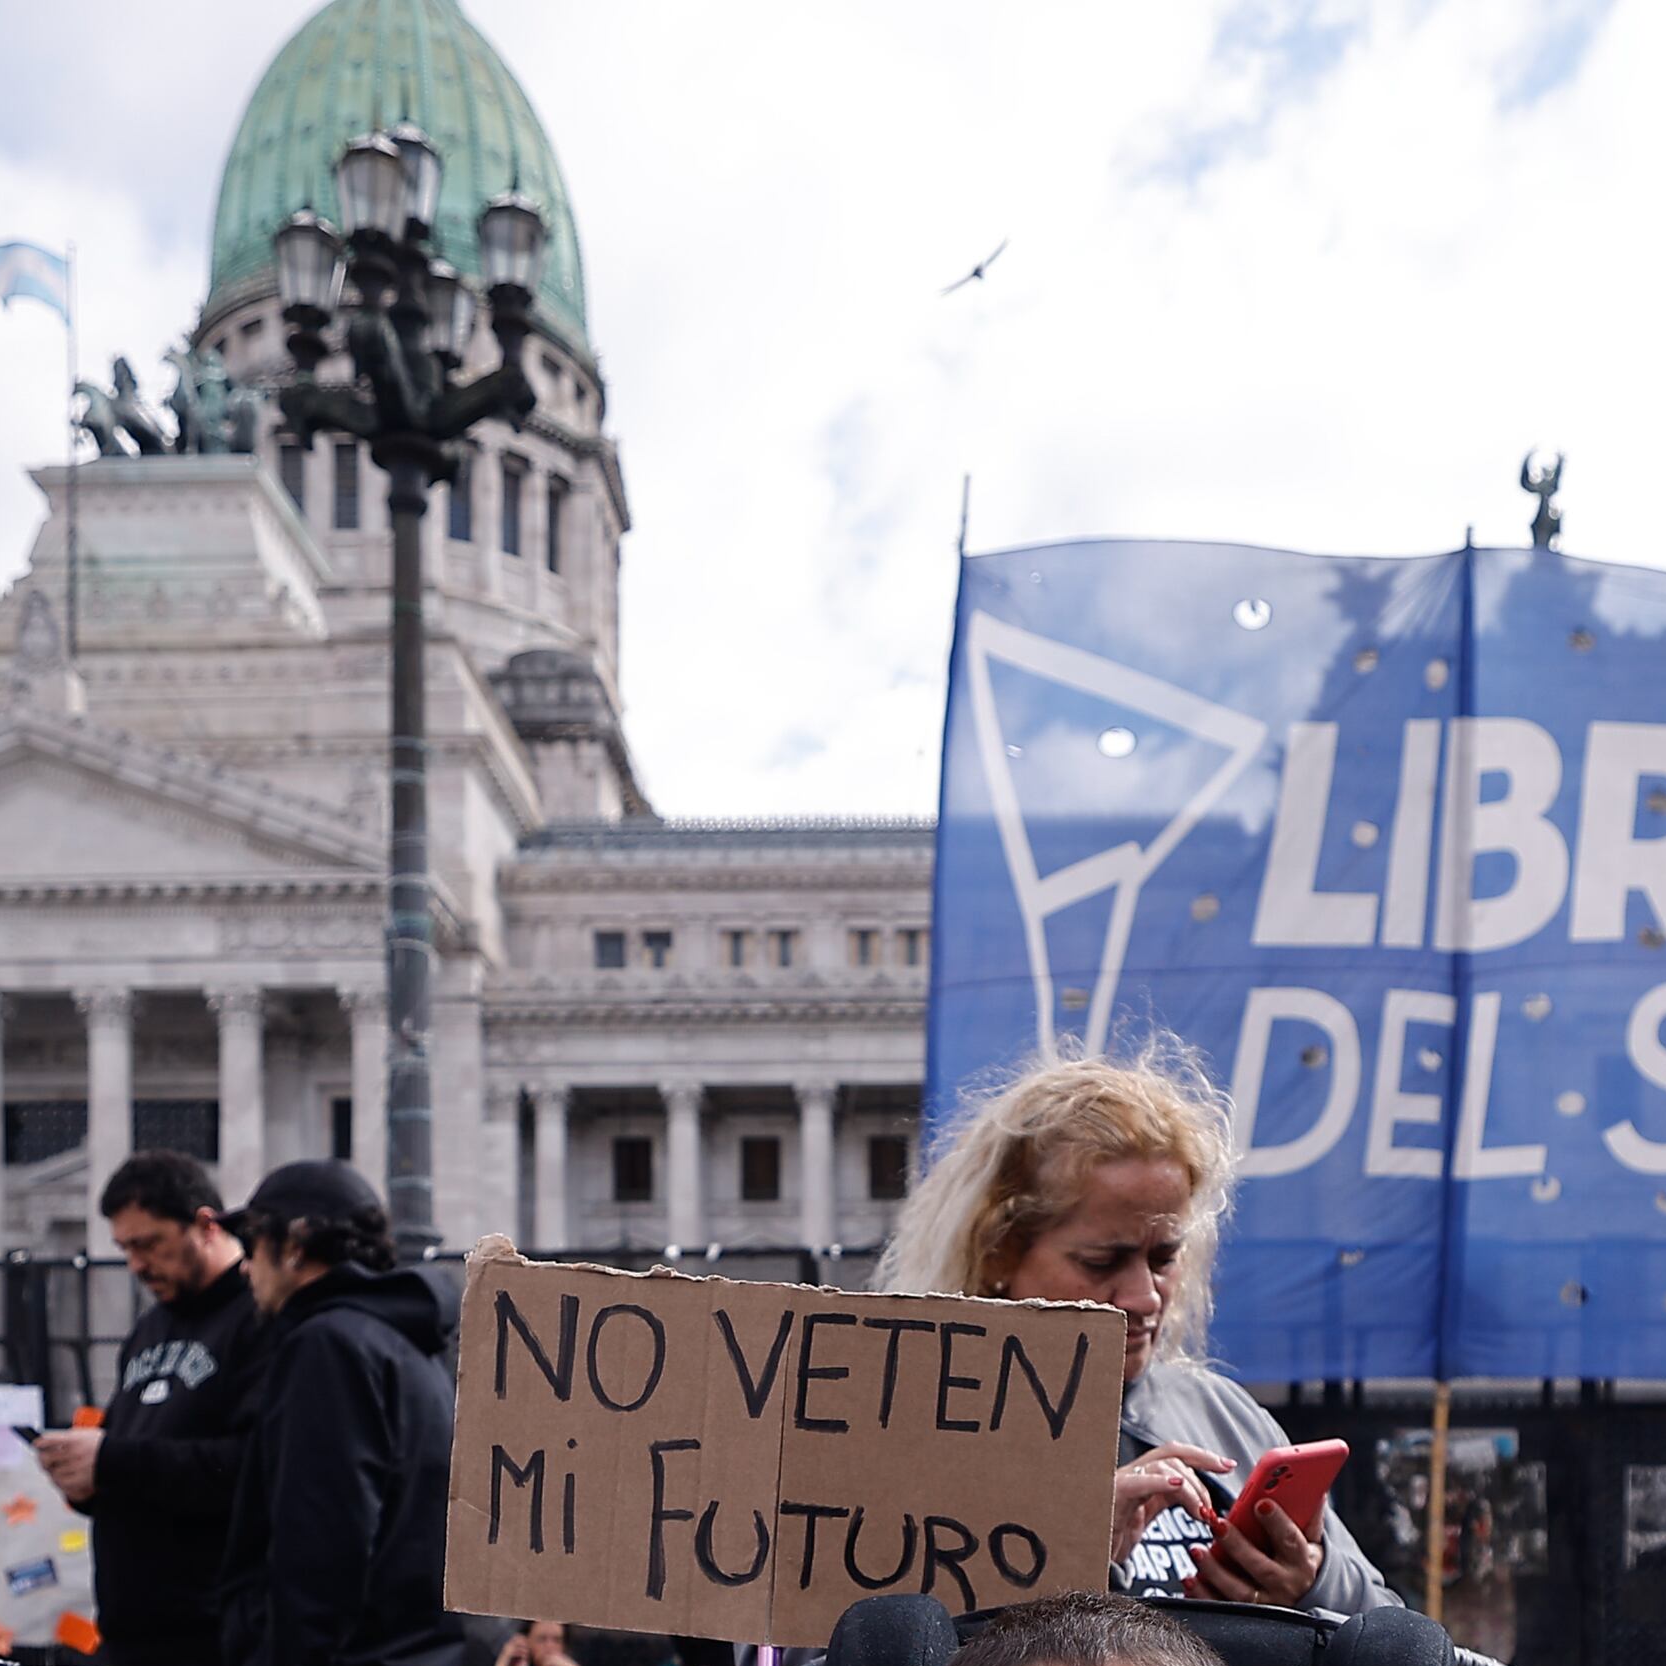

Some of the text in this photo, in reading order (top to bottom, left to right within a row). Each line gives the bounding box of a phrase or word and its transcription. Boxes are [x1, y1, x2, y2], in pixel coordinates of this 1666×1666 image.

[1229, 988, 1546, 1180] DEL
[494, 1290, 1090, 1440] NO VETEN
[645, 1438, 1047, 1612] FUTURO
